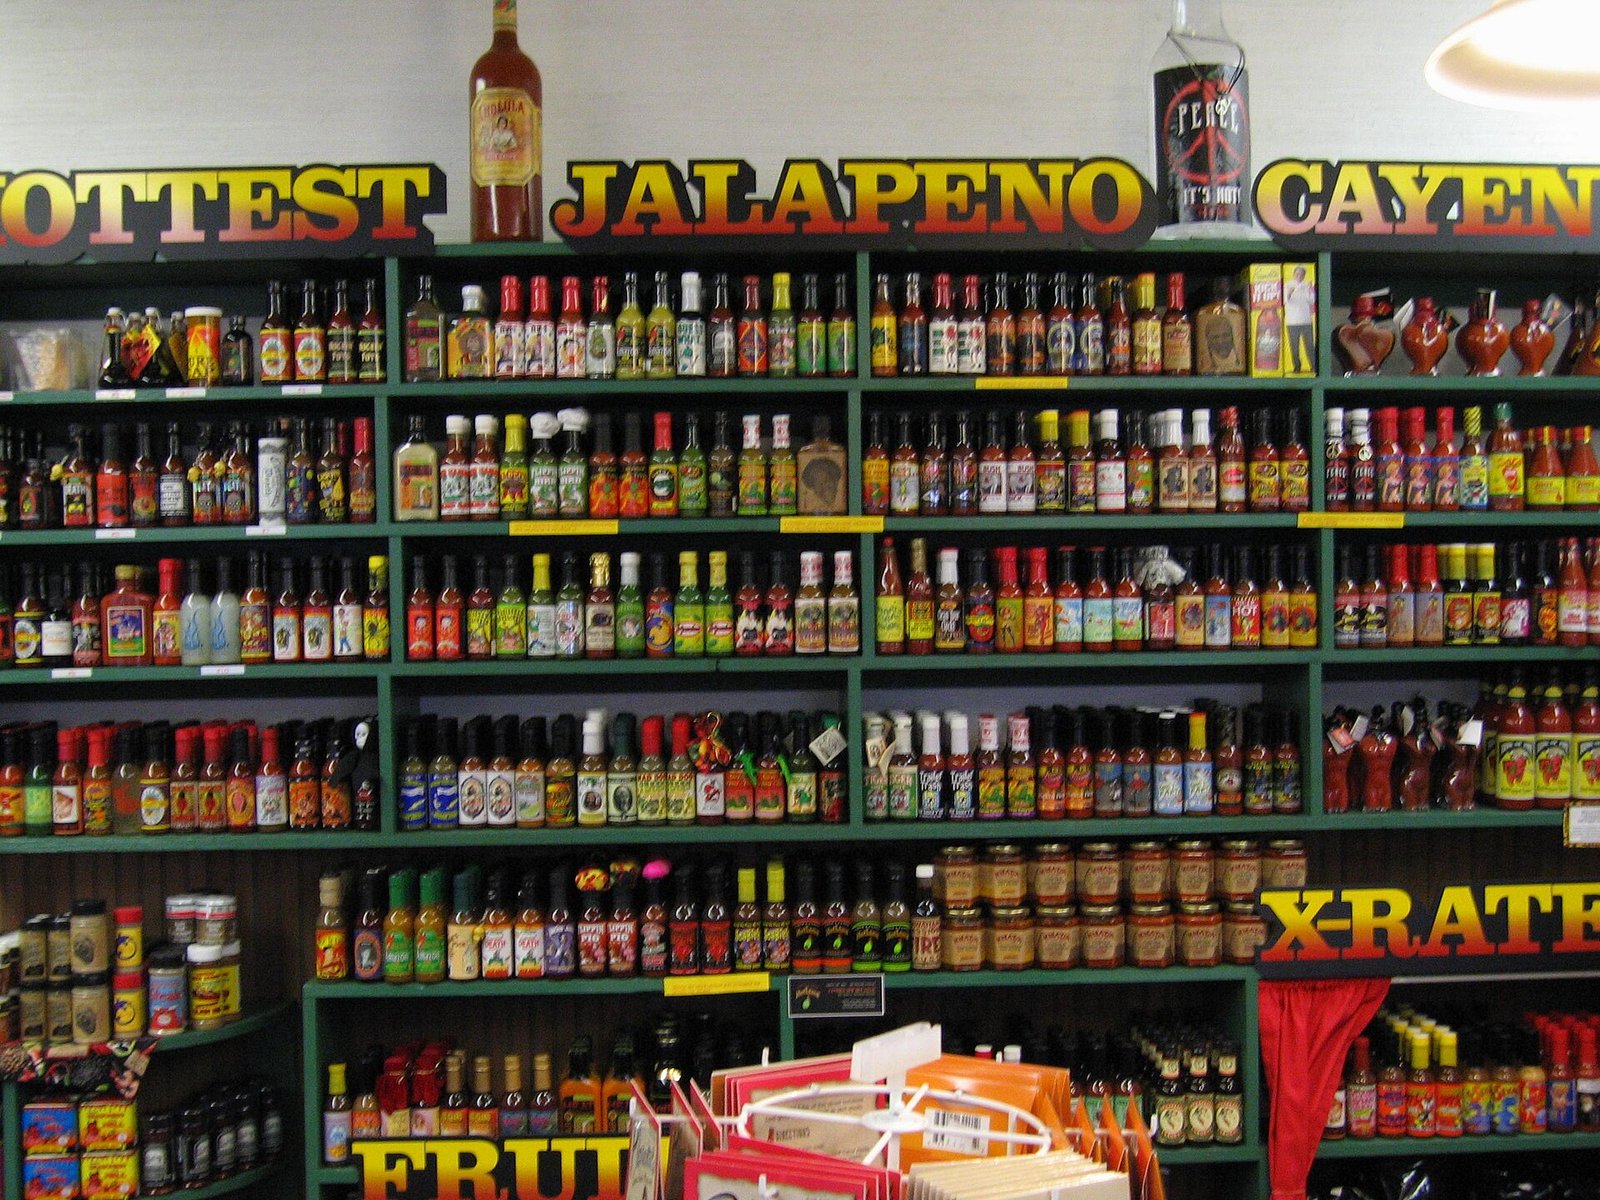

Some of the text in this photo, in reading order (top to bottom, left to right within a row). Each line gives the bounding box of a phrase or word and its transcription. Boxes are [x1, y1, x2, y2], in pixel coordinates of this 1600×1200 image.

[0, 166, 430, 248] OTTEST
[554, 160, 1143, 236] JALAPENO
[1256, 161, 1600, 237] CAYEN
[1259, 883, 1600, 962] X-RATE
[351, 1138, 670, 1200] FRUI
